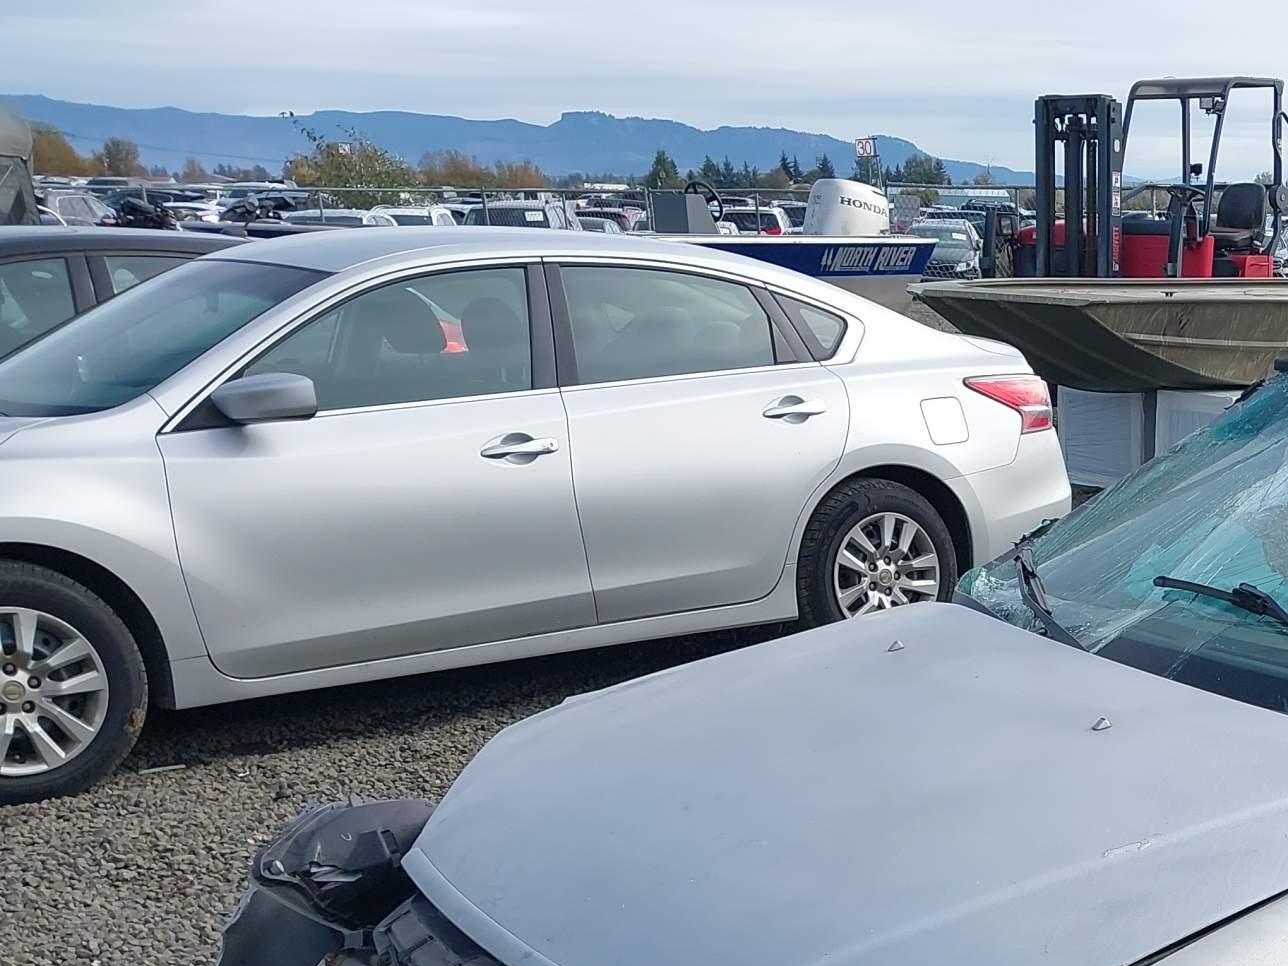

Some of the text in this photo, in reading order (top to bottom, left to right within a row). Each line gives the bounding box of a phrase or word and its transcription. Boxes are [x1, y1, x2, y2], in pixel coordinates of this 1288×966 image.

[857, 140, 872, 156] 30
[840, 195, 889, 218] HONDA
[829, 246, 917, 272] NORTH RIVER
